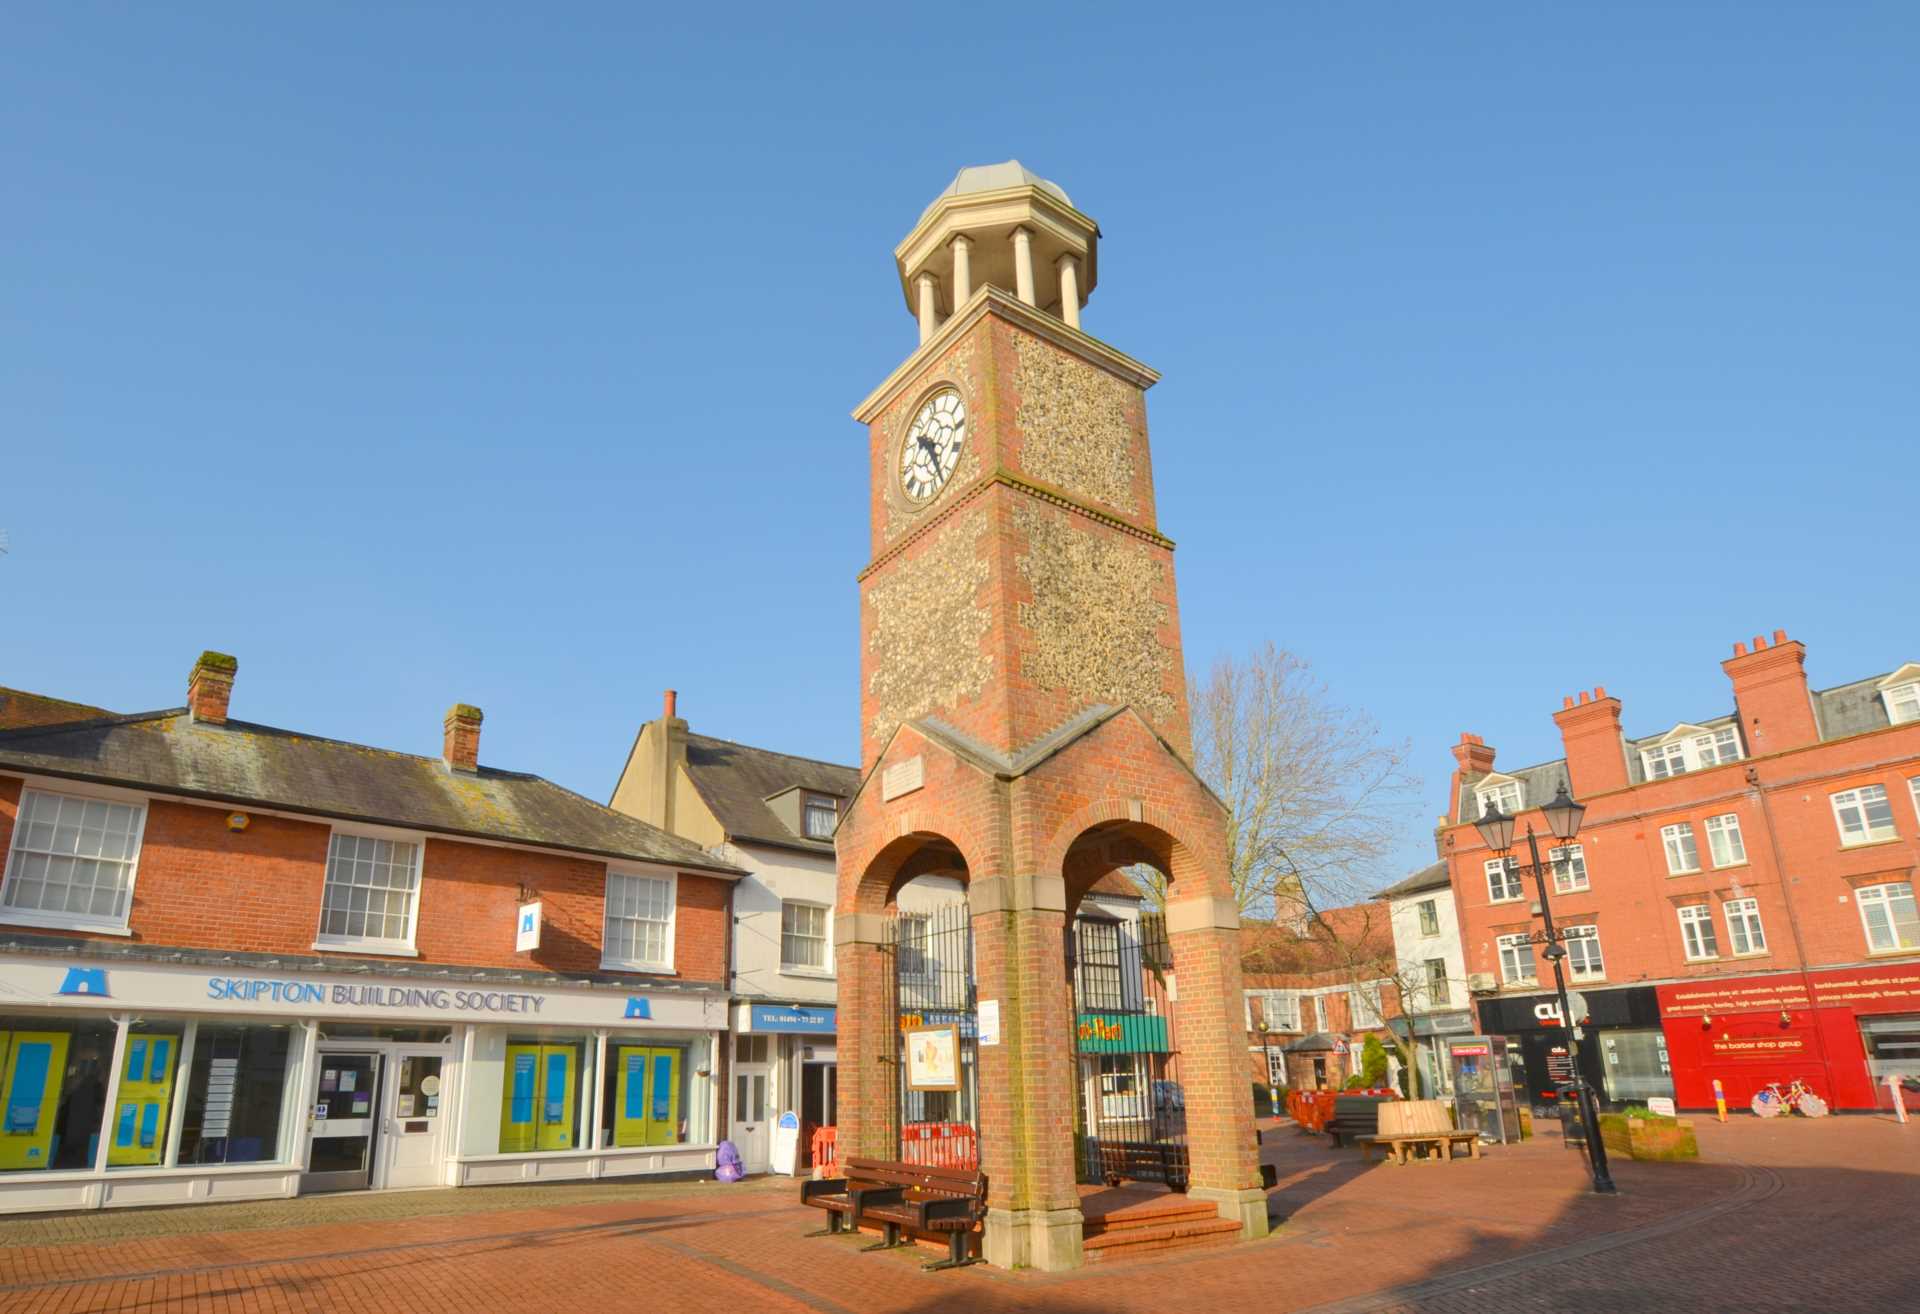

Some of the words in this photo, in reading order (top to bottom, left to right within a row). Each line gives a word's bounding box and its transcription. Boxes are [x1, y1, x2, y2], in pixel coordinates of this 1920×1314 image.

[207, 977, 325, 1004] SKIPTON
[331, 985, 451, 1010] BUILDING
[454, 990, 545, 1013] SOCIETY
[1713, 1042, 1728, 1050] the
[1728, 1042, 1756, 1050] barber
[1756, 1041, 1777, 1049] shop
[1777, 1040, 1803, 1049] group
